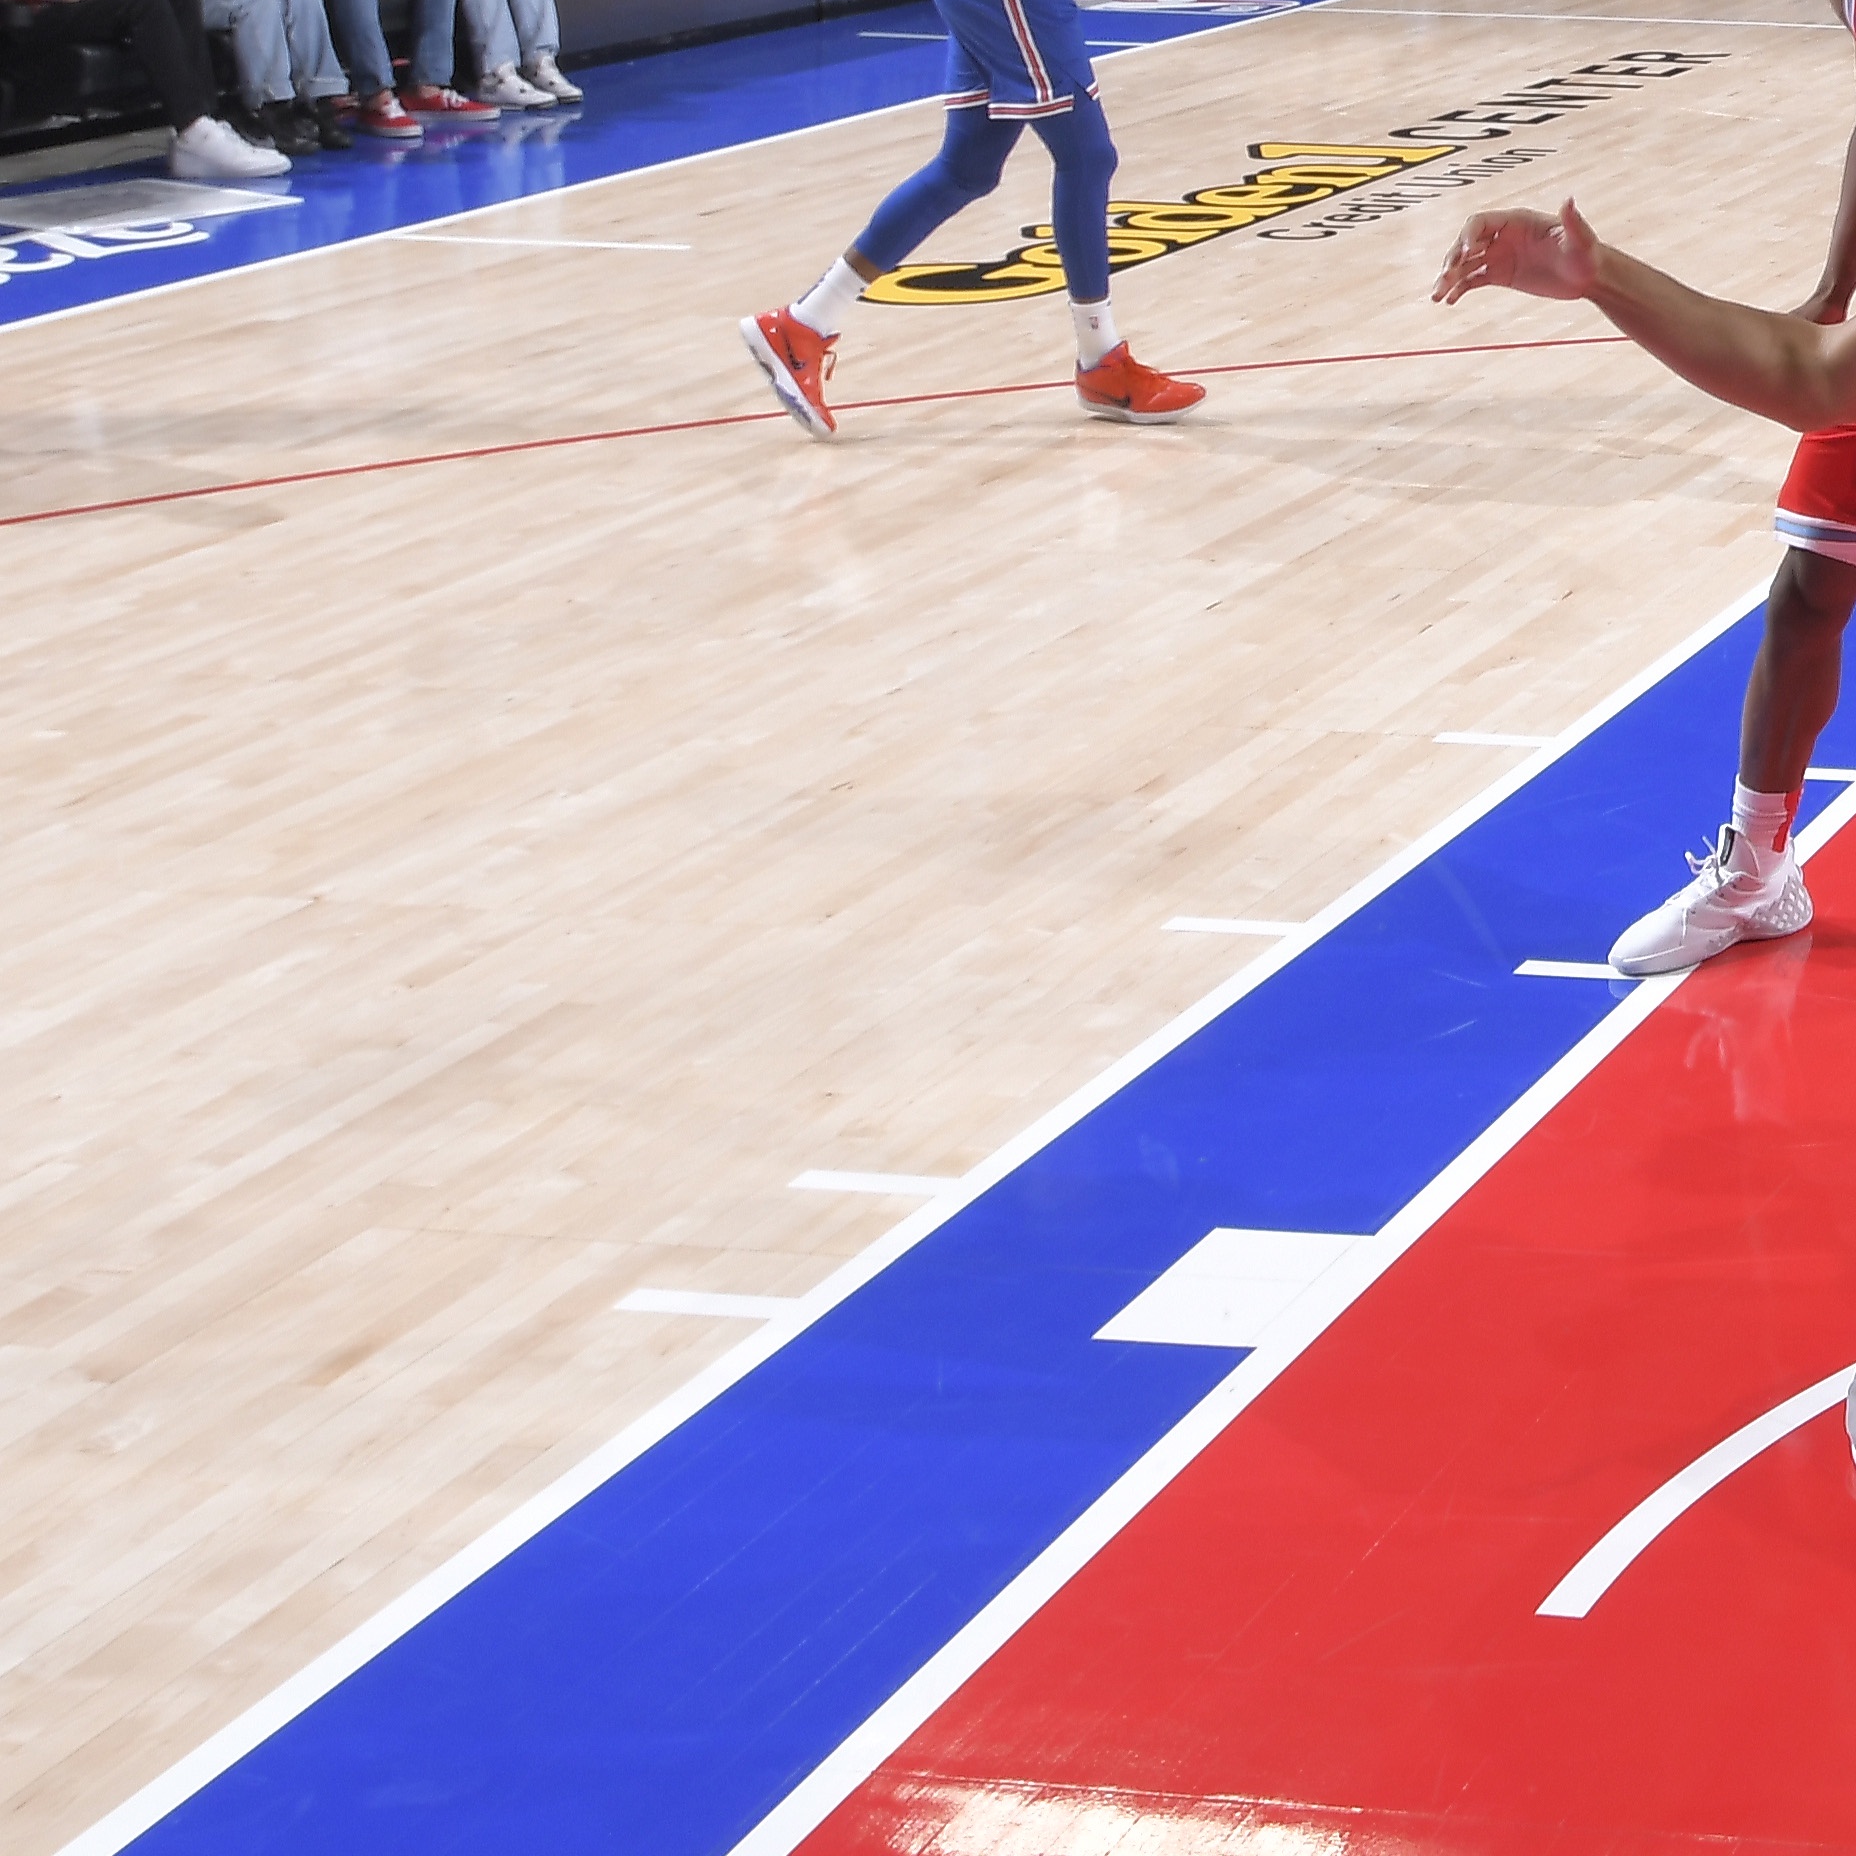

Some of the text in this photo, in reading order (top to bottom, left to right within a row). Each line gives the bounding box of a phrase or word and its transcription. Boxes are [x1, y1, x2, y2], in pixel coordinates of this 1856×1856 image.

[1388, 48, 1732, 142] CENTER
[1257, 145, 1558, 242] Credit Union
